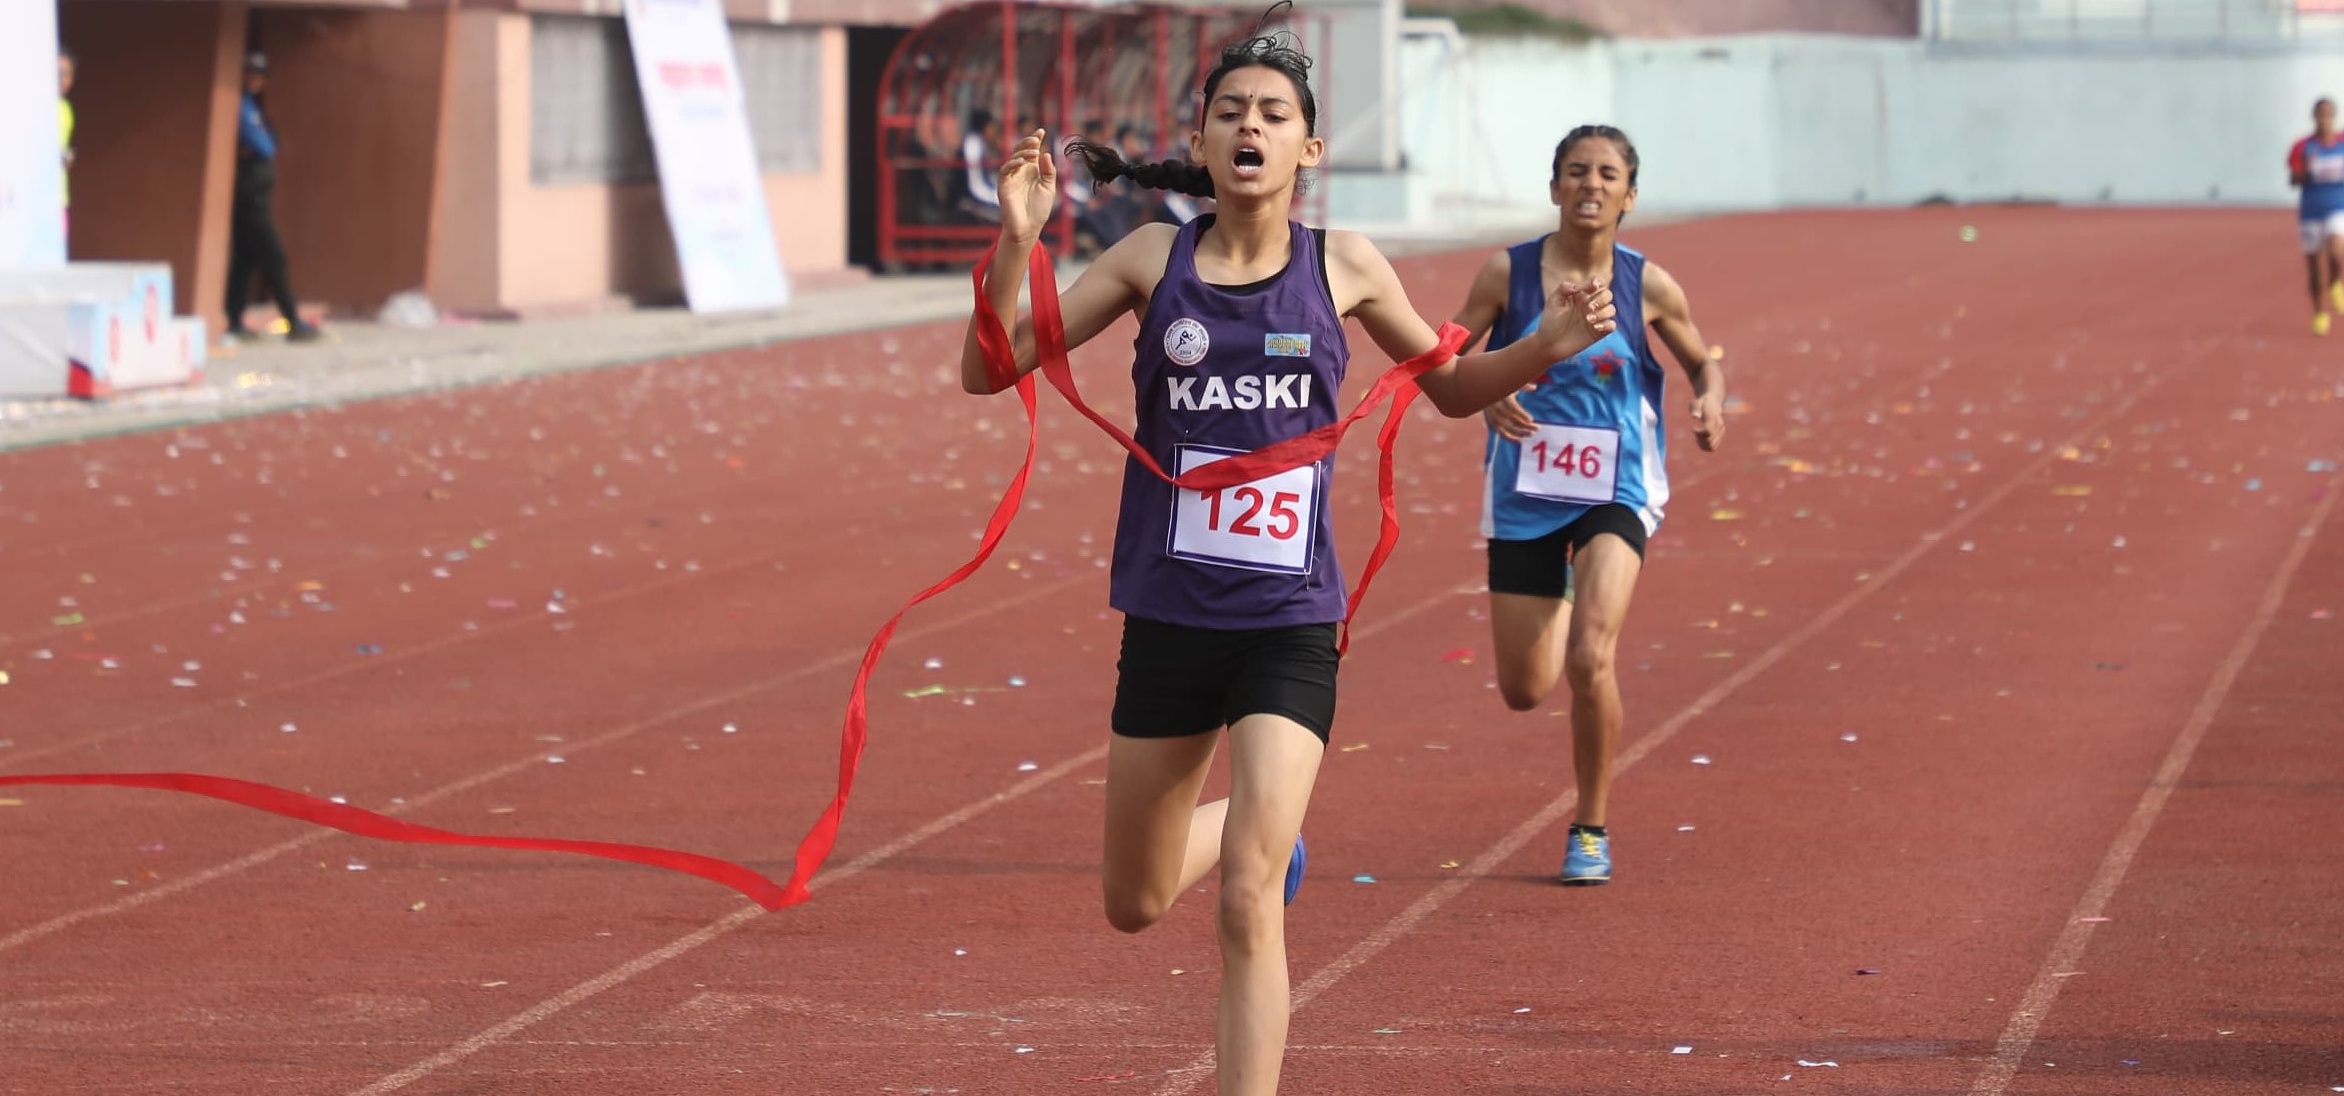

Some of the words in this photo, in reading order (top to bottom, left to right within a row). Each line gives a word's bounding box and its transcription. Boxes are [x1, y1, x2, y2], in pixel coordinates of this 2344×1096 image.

[1167, 374, 1311, 410] KASKI
[1532, 441, 1601, 478] 146
[1200, 486, 1300, 539] 125
